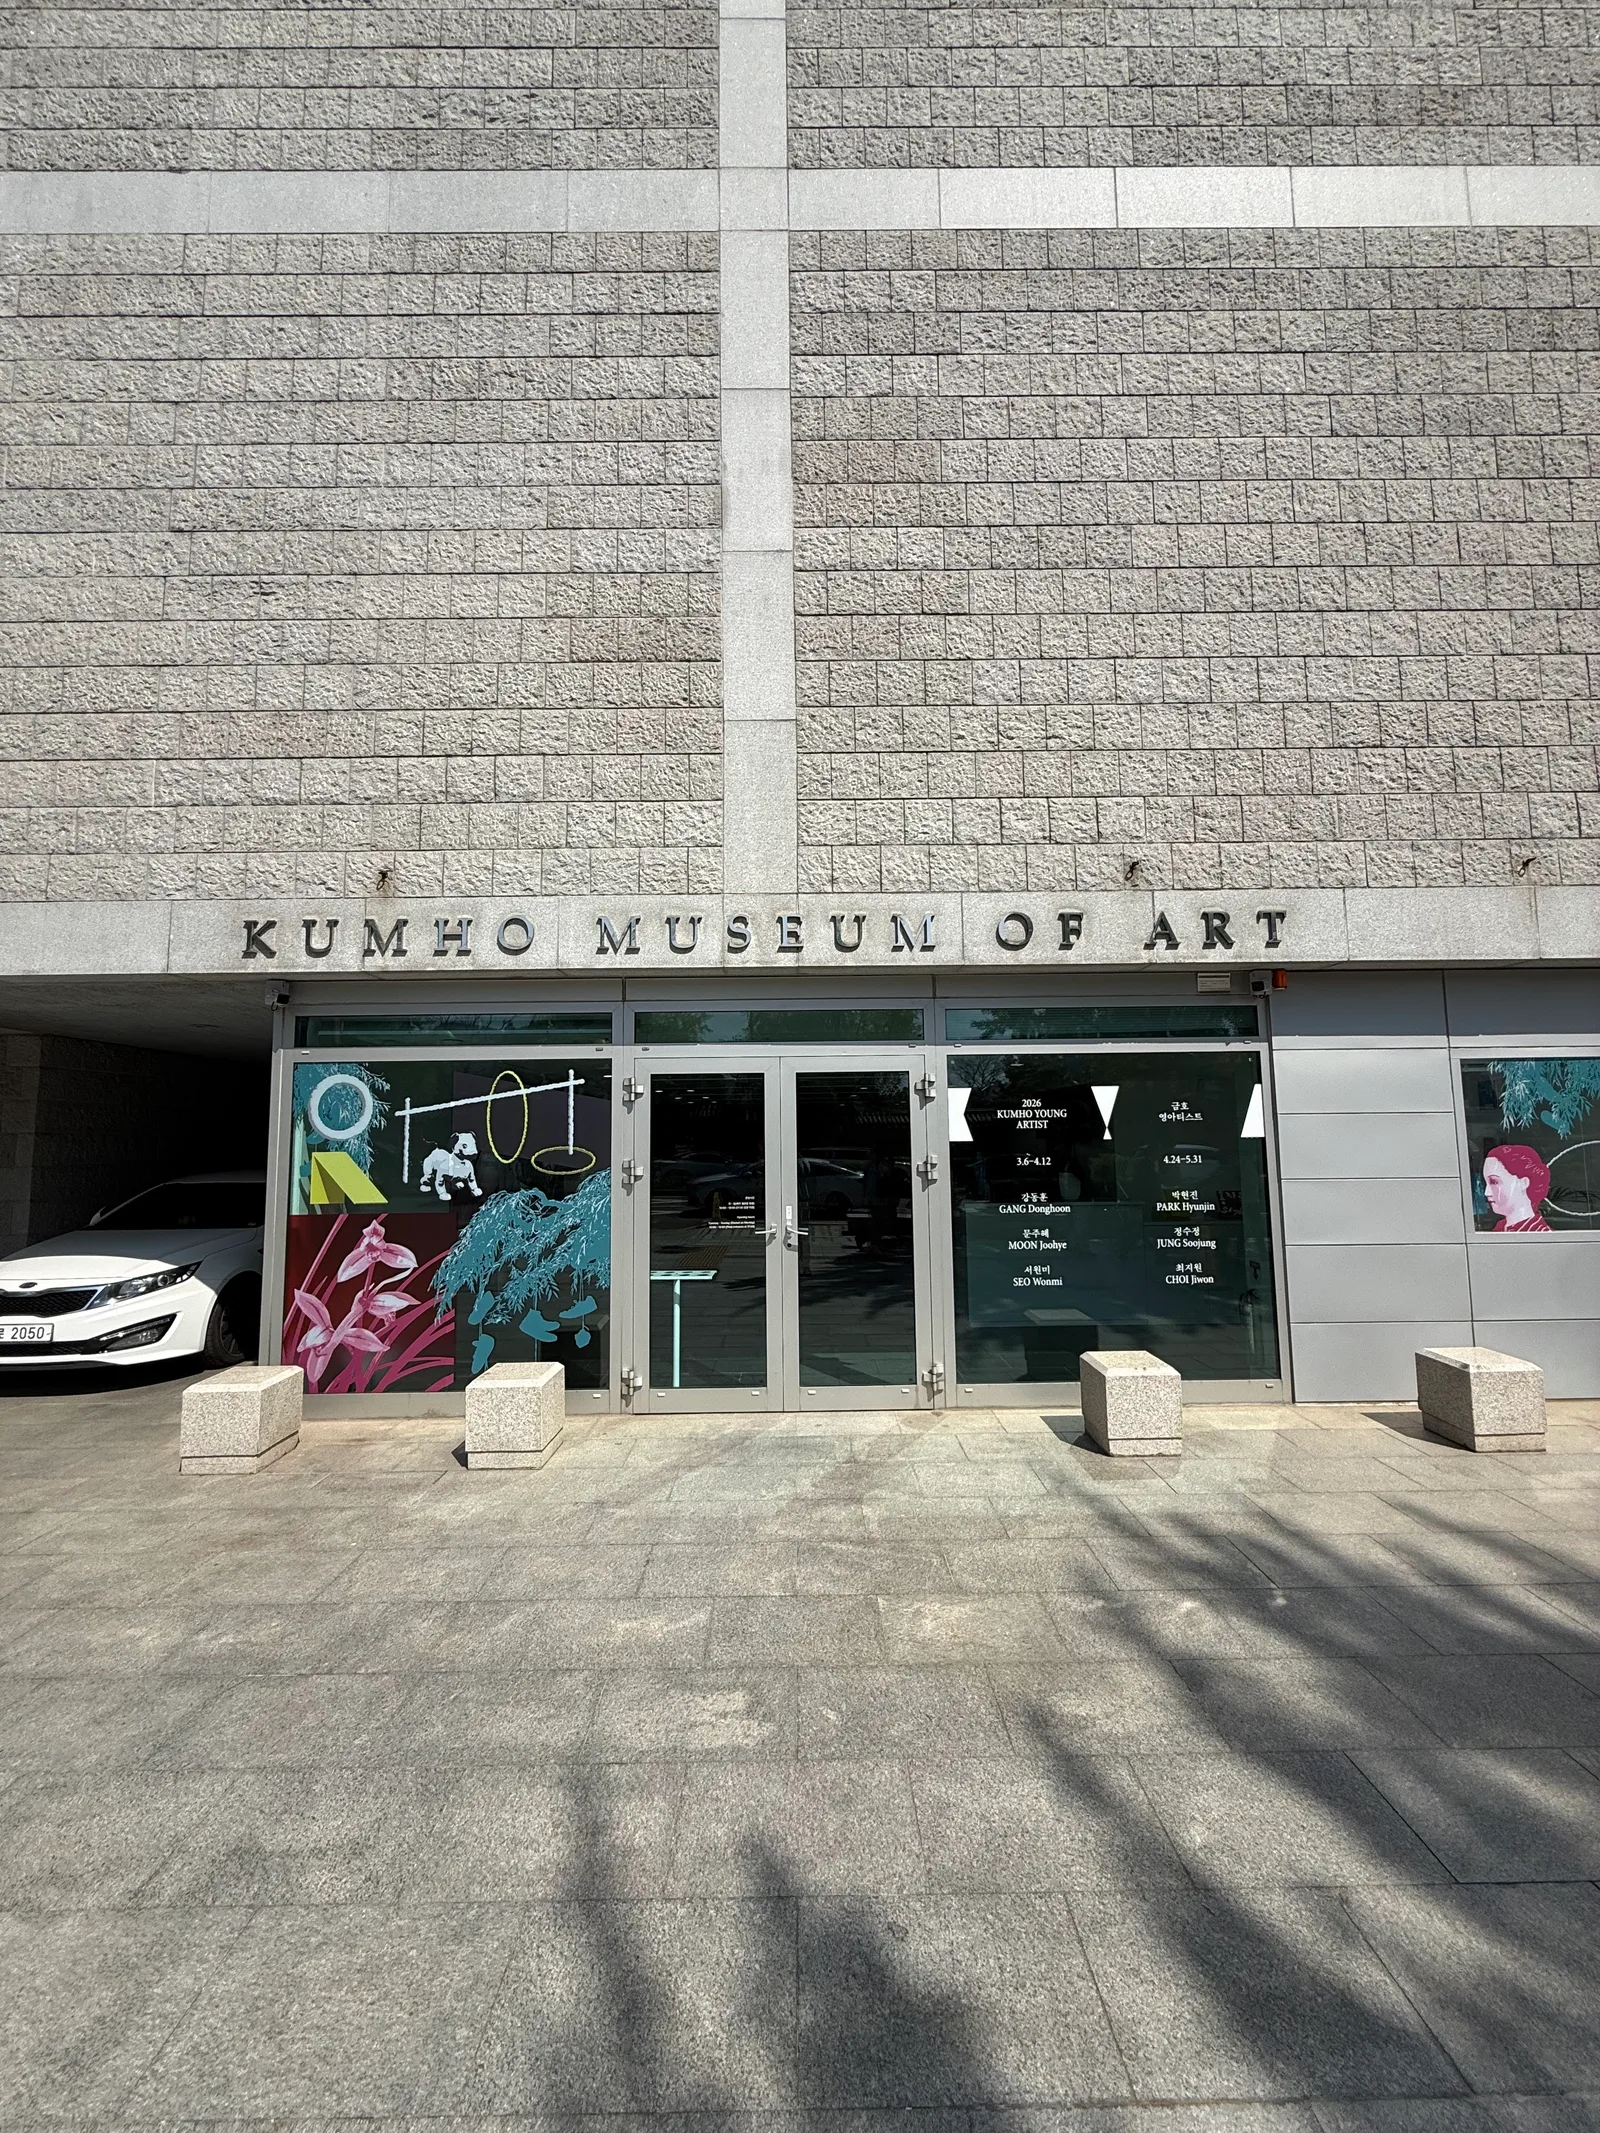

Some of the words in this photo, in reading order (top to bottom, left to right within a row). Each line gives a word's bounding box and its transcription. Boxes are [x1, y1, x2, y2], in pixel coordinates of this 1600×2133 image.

[241, 915, 535, 959] KUMHO
[596, 913, 936, 956] MUSEUM
[996, 911, 1084, 951] OF
[1143, 910, 1287, 950] ART
[1021, 1098, 1042, 1108] 2026
[1170, 1101, 1190, 1111] 금호
[996, 1109, 1033, 1119] KUMHO
[1034, 1108, 1068, 1118] YOUNG
[1158, 1112, 1203, 1122] 영아티스트
[1016, 1119, 1049, 1129] ARTIST
[1021, 1192, 1048, 1202] 강동훈
[1171, 1189, 1199, 1200] 박현진
[999, 1204, 1027, 1214] GANG
[1028, 1204, 1071, 1215] Donghoon
[1156, 1202, 1181, 1212] PARK
[1182, 1201, 1216, 1213] Hyunjin
[1022, 1228, 1050, 1239] 문주혜
[1173, 1225, 1200, 1237] 정수정
[1008, 1241, 1038, 1250] MOON
[1039, 1240, 1067, 1252] Joohye
[1156, 1238, 1181, 1250] JUNG
[1182, 1238, 1217, 1250] Soojung
[1024, 1265, 1050, 1275] 서원미
[1175, 1263, 1202, 1273] 최지원
[1013, 1277, 1031, 1286] SEO
[1032, 1277, 1063, 1286] Wonmi
[1165, 1275, 1189, 1284] CHOI
[1190, 1275, 1214, 1285] Jiwon
[11, 1327, 44, 1339] 2050
